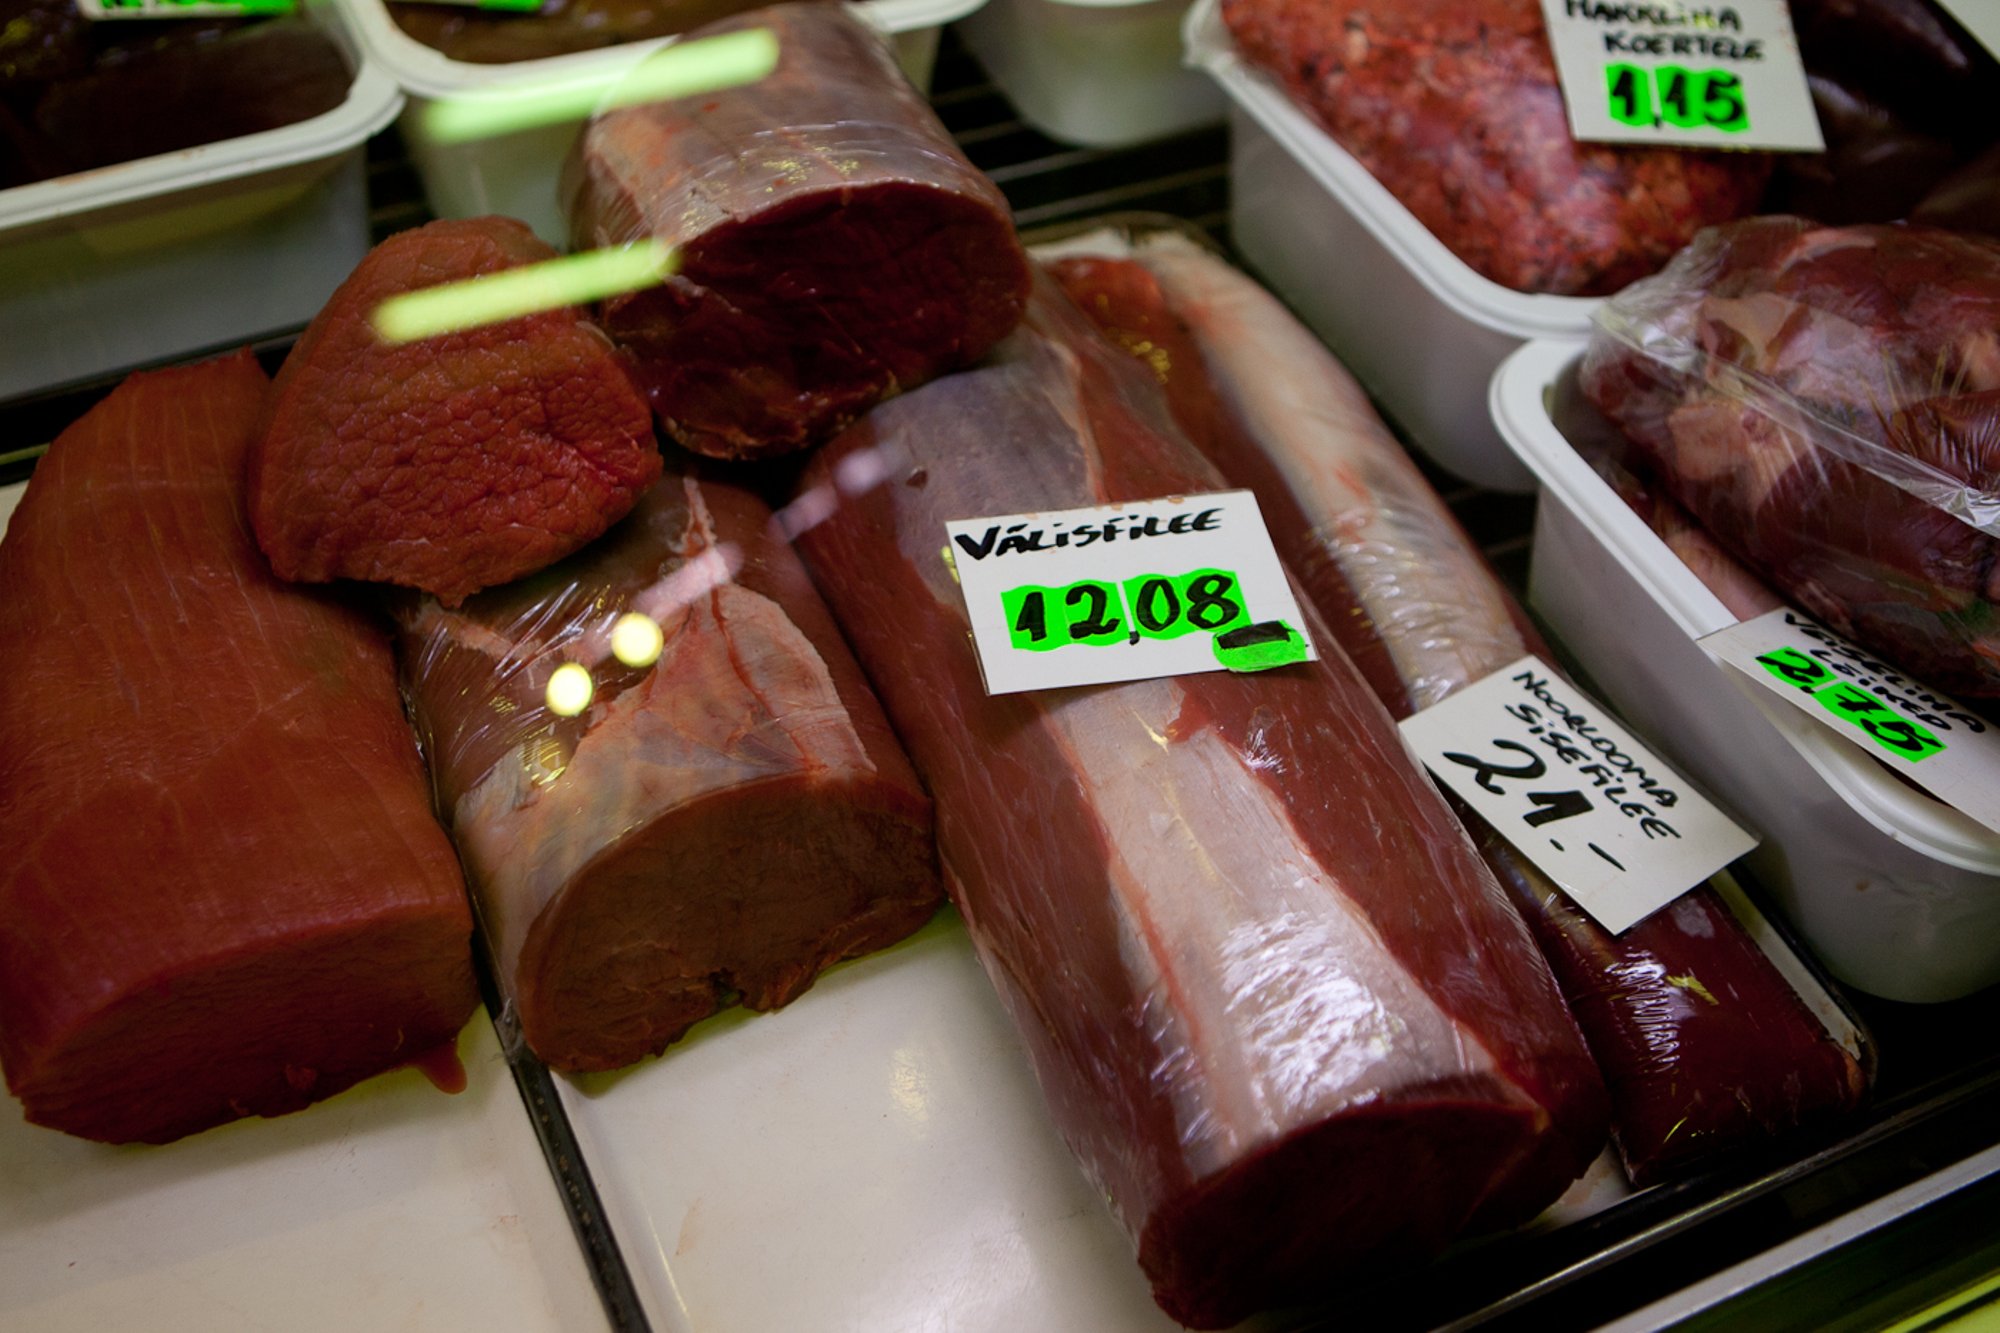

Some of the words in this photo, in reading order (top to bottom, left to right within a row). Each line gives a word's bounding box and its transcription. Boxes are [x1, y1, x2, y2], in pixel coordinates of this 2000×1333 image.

[1604, 31, 1764, 61] KOERTELE
[1612, 70, 1742, 128] 1,15
[1015, 574, 1241, 645] 12,08
[1504, 703, 1682, 839] SISEFILEE
[1512, 671, 1680, 807] NOORLOOMA
